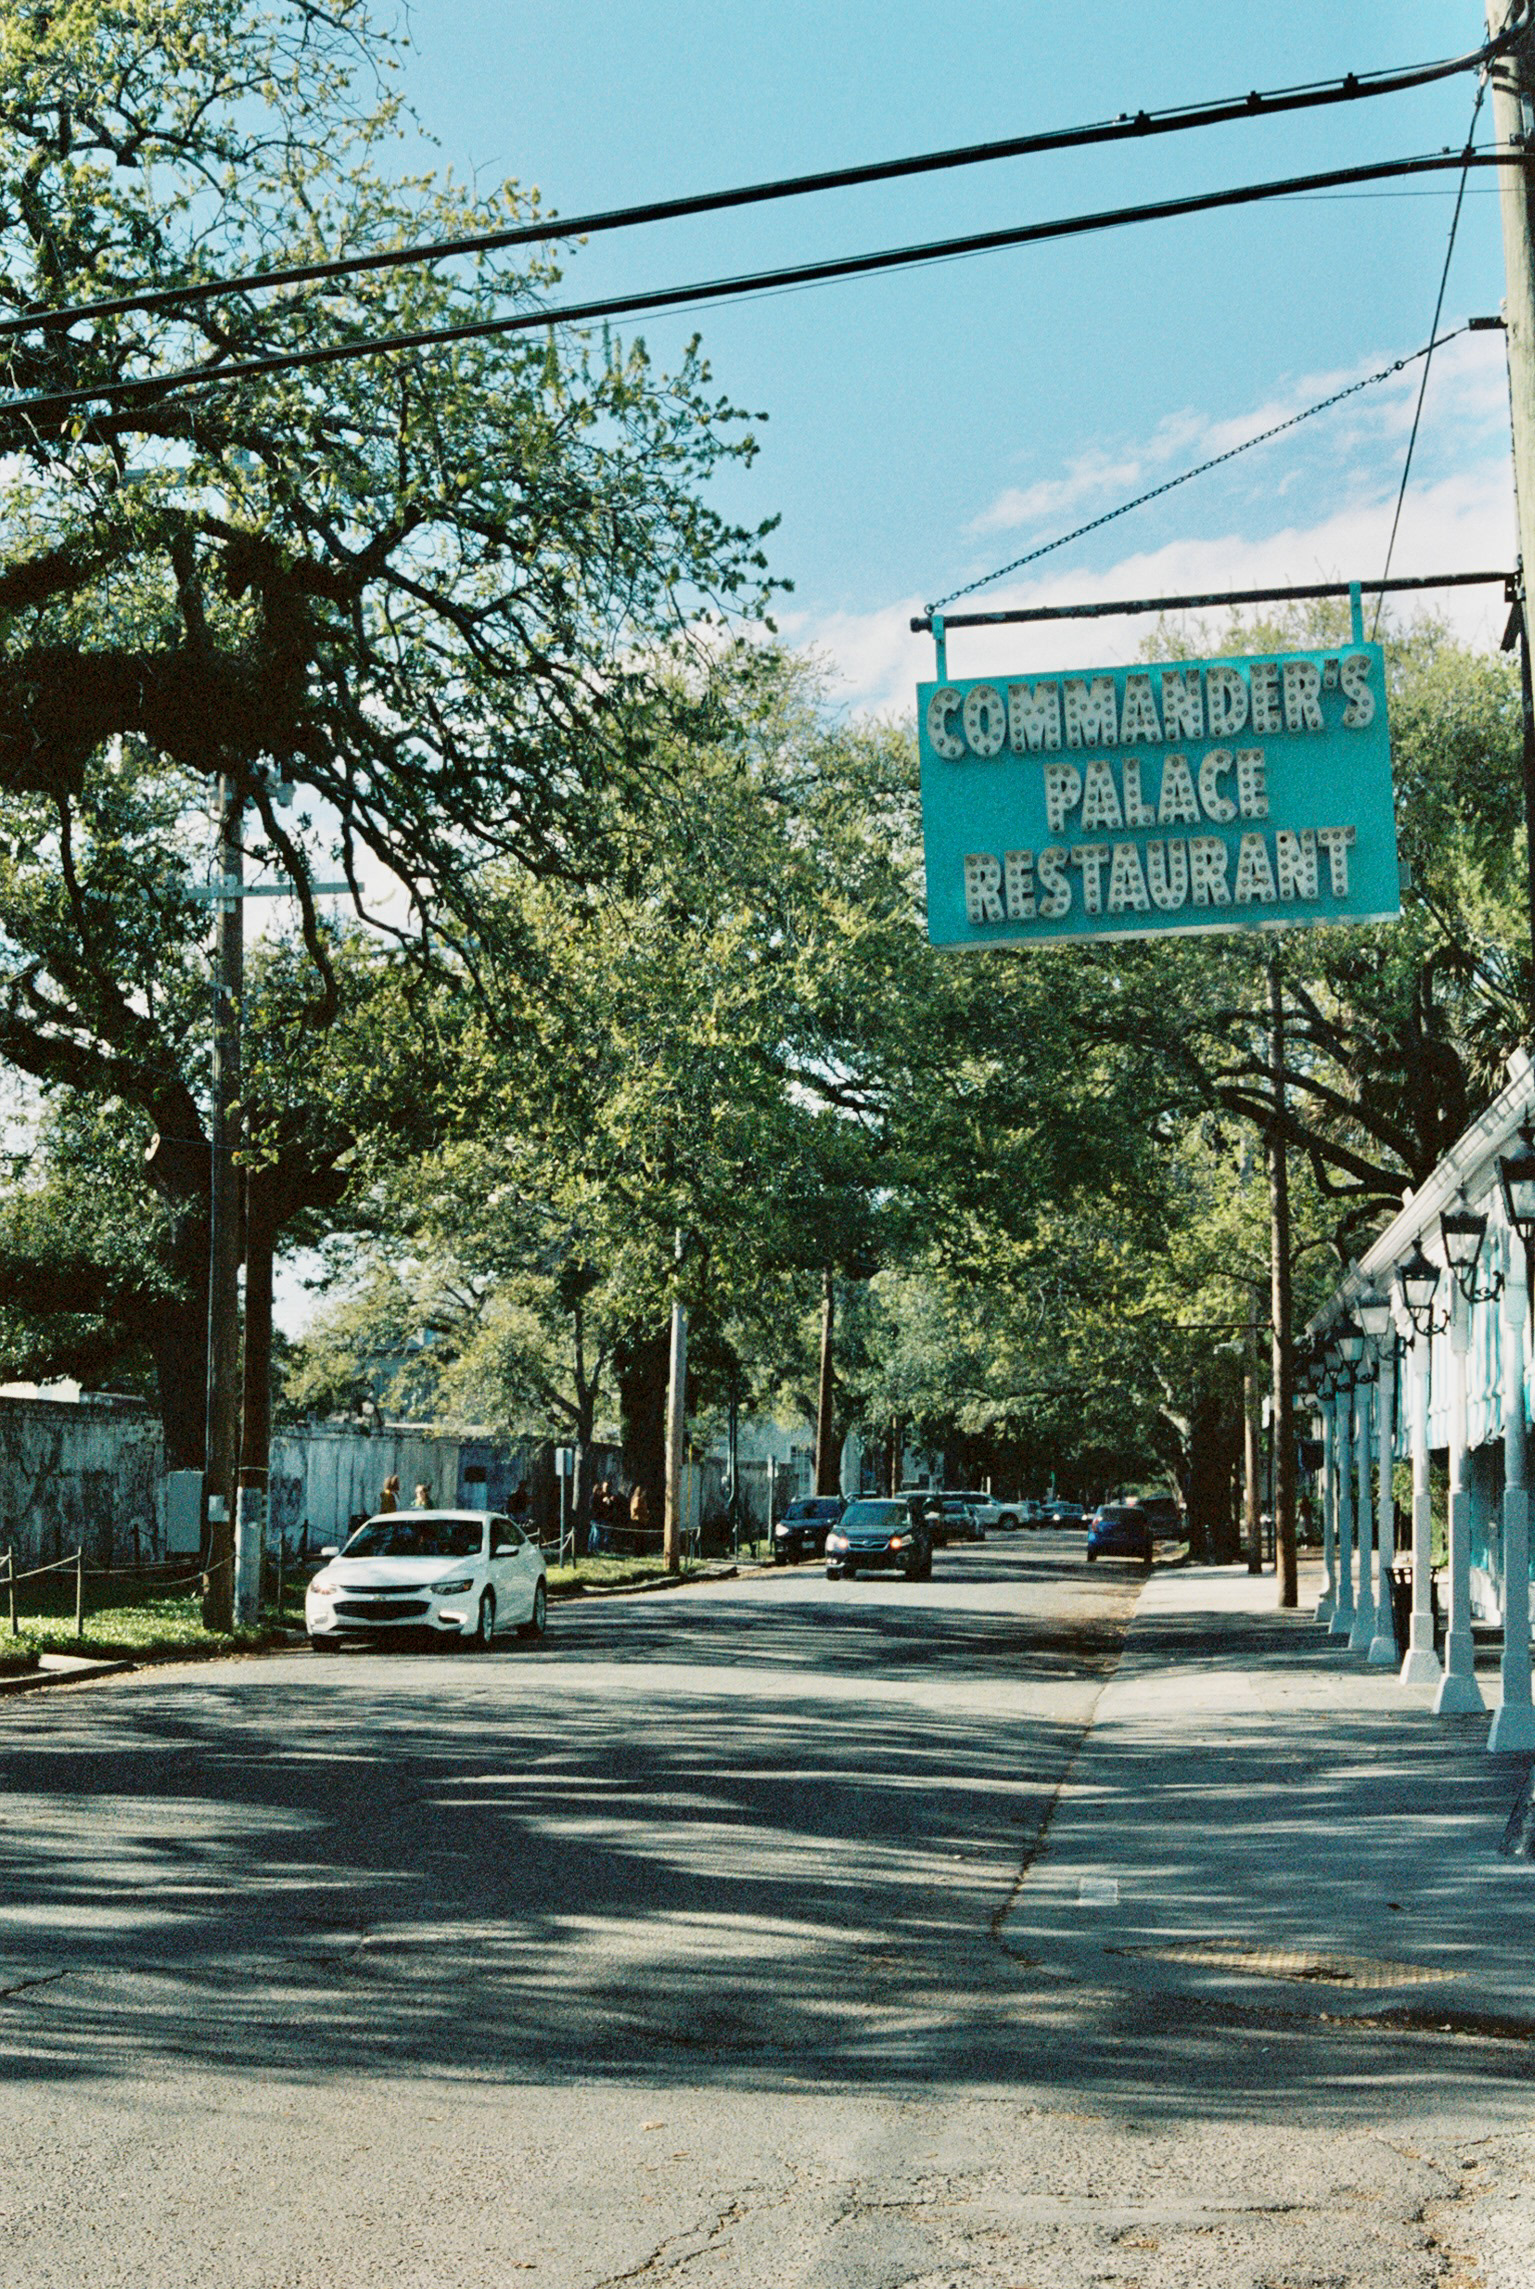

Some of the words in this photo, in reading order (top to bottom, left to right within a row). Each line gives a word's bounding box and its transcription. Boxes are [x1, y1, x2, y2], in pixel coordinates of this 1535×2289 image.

[927, 654, 1376, 760] COMMANDER'S
[1043, 748, 1269, 833] PALACE
[964, 825, 1356, 925] RESTAURANT
